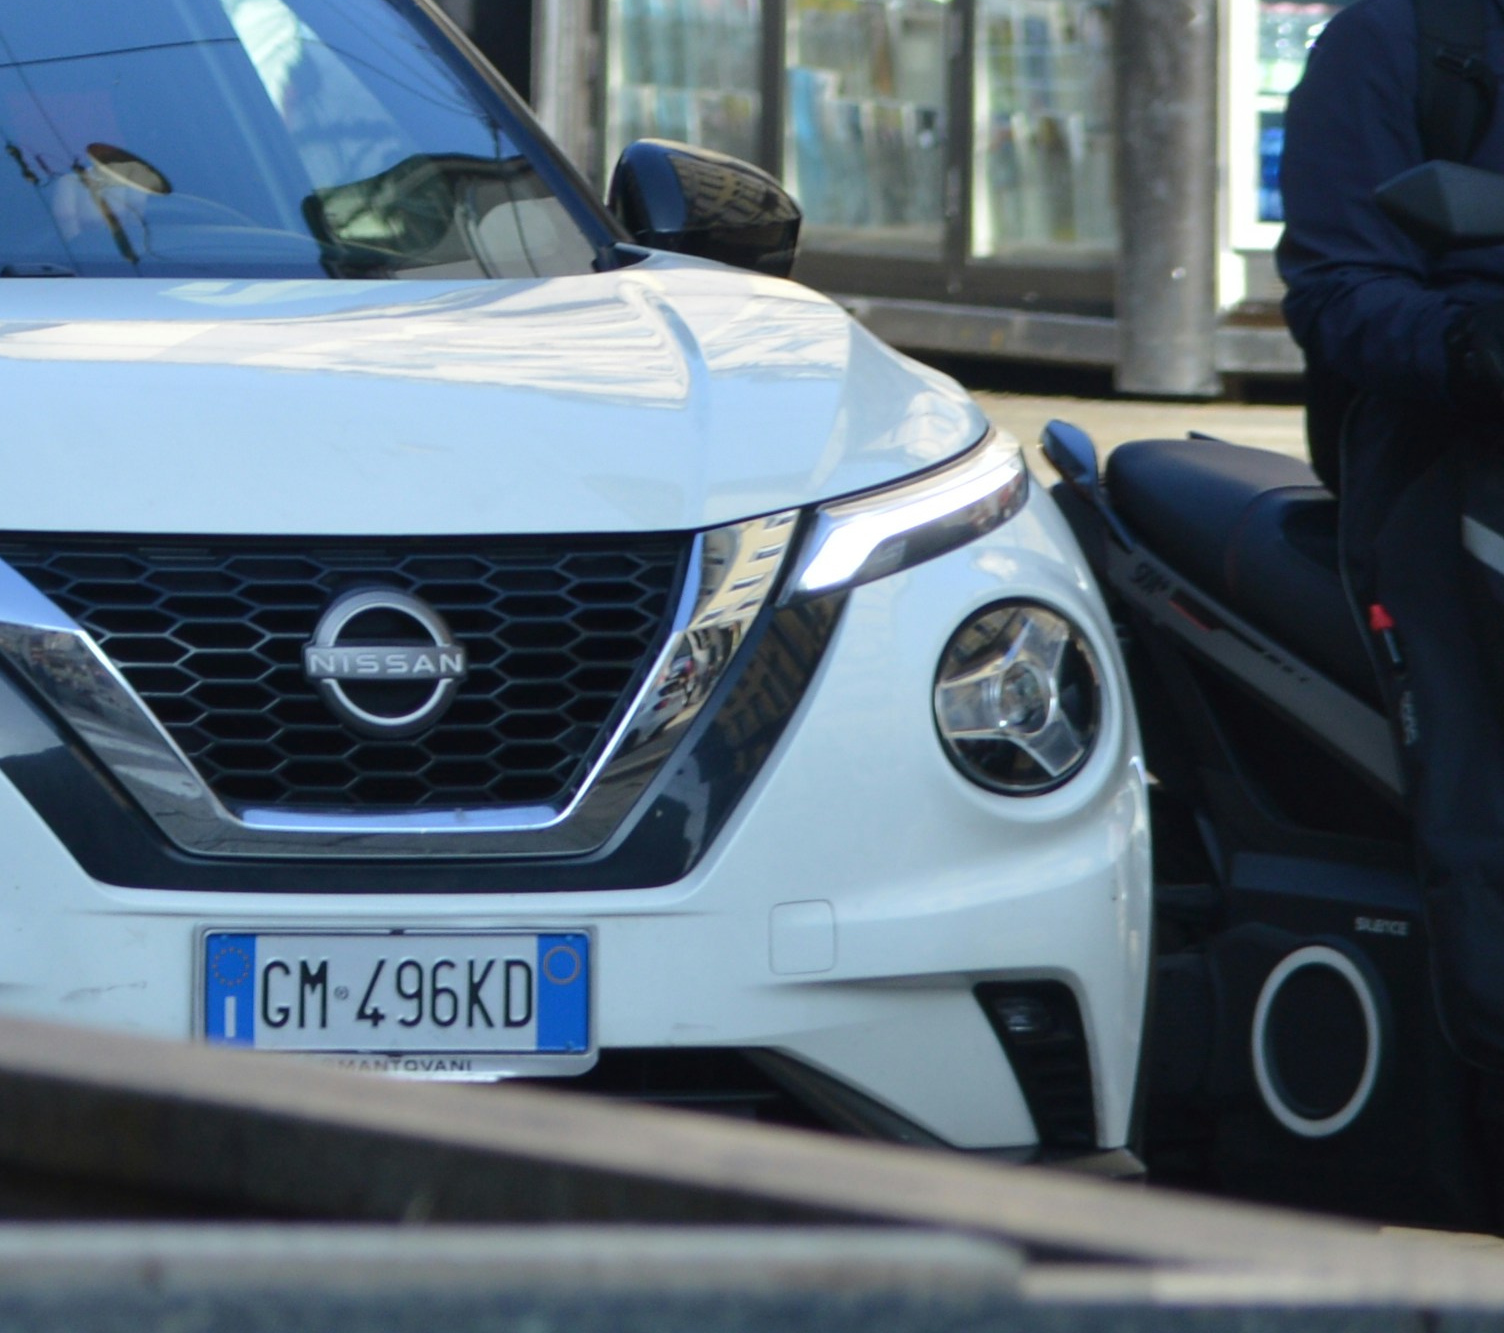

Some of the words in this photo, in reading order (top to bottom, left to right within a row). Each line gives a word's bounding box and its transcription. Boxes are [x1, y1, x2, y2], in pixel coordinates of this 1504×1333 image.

[310, 653, 464, 674] NISSAN
[261, 959, 329, 1029] GM
[356, 959, 533, 1029] 496KD
